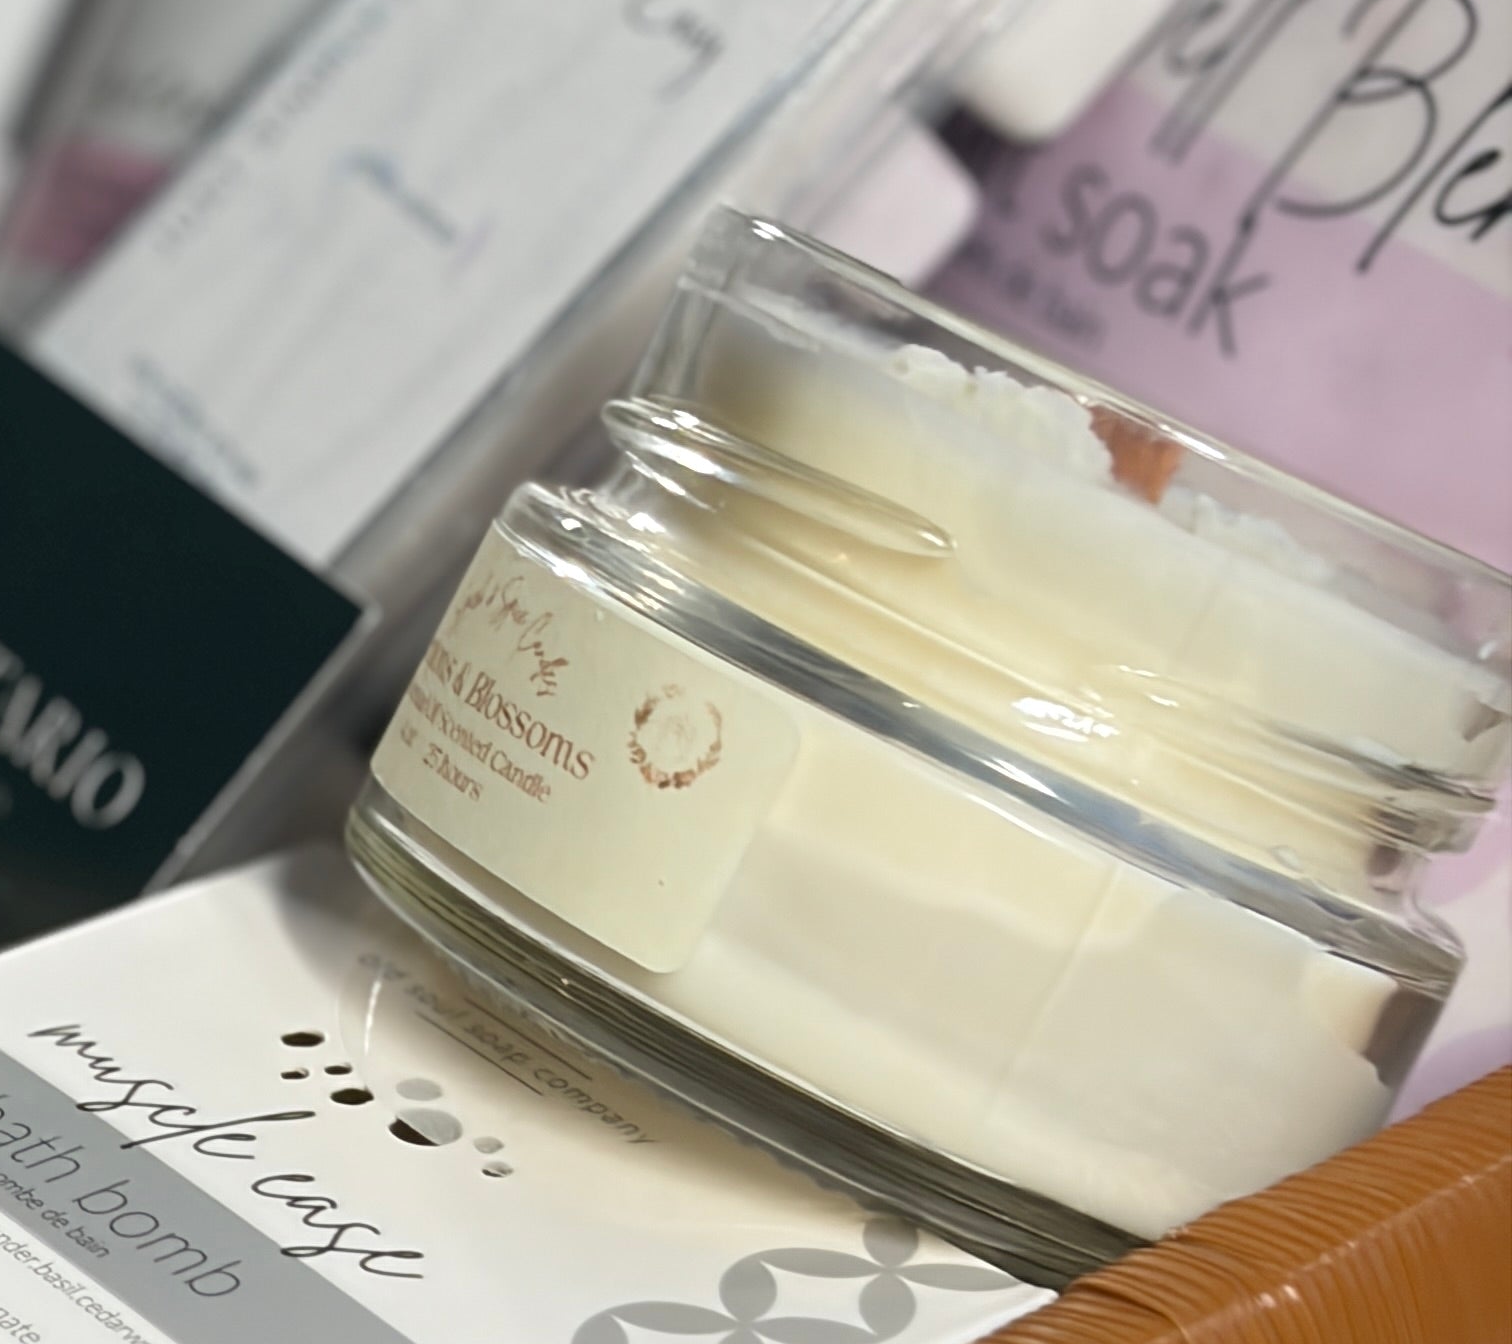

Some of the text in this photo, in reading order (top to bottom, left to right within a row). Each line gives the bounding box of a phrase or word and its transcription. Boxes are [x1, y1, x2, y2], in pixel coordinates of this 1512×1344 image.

[1036, 159, 1271, 362] soak
[464, 670, 596, 781] Blossoms
[489, 749, 552, 804] Candle
[462, 1020, 529, 1067] soap
[532, 1065, 661, 1146] company
[27, 1023, 425, 1280] muscle ease
[40, 1206, 70, 1230] de
[65, 1223, 112, 1261] bain
[72, 1178, 244, 1298] bomb
